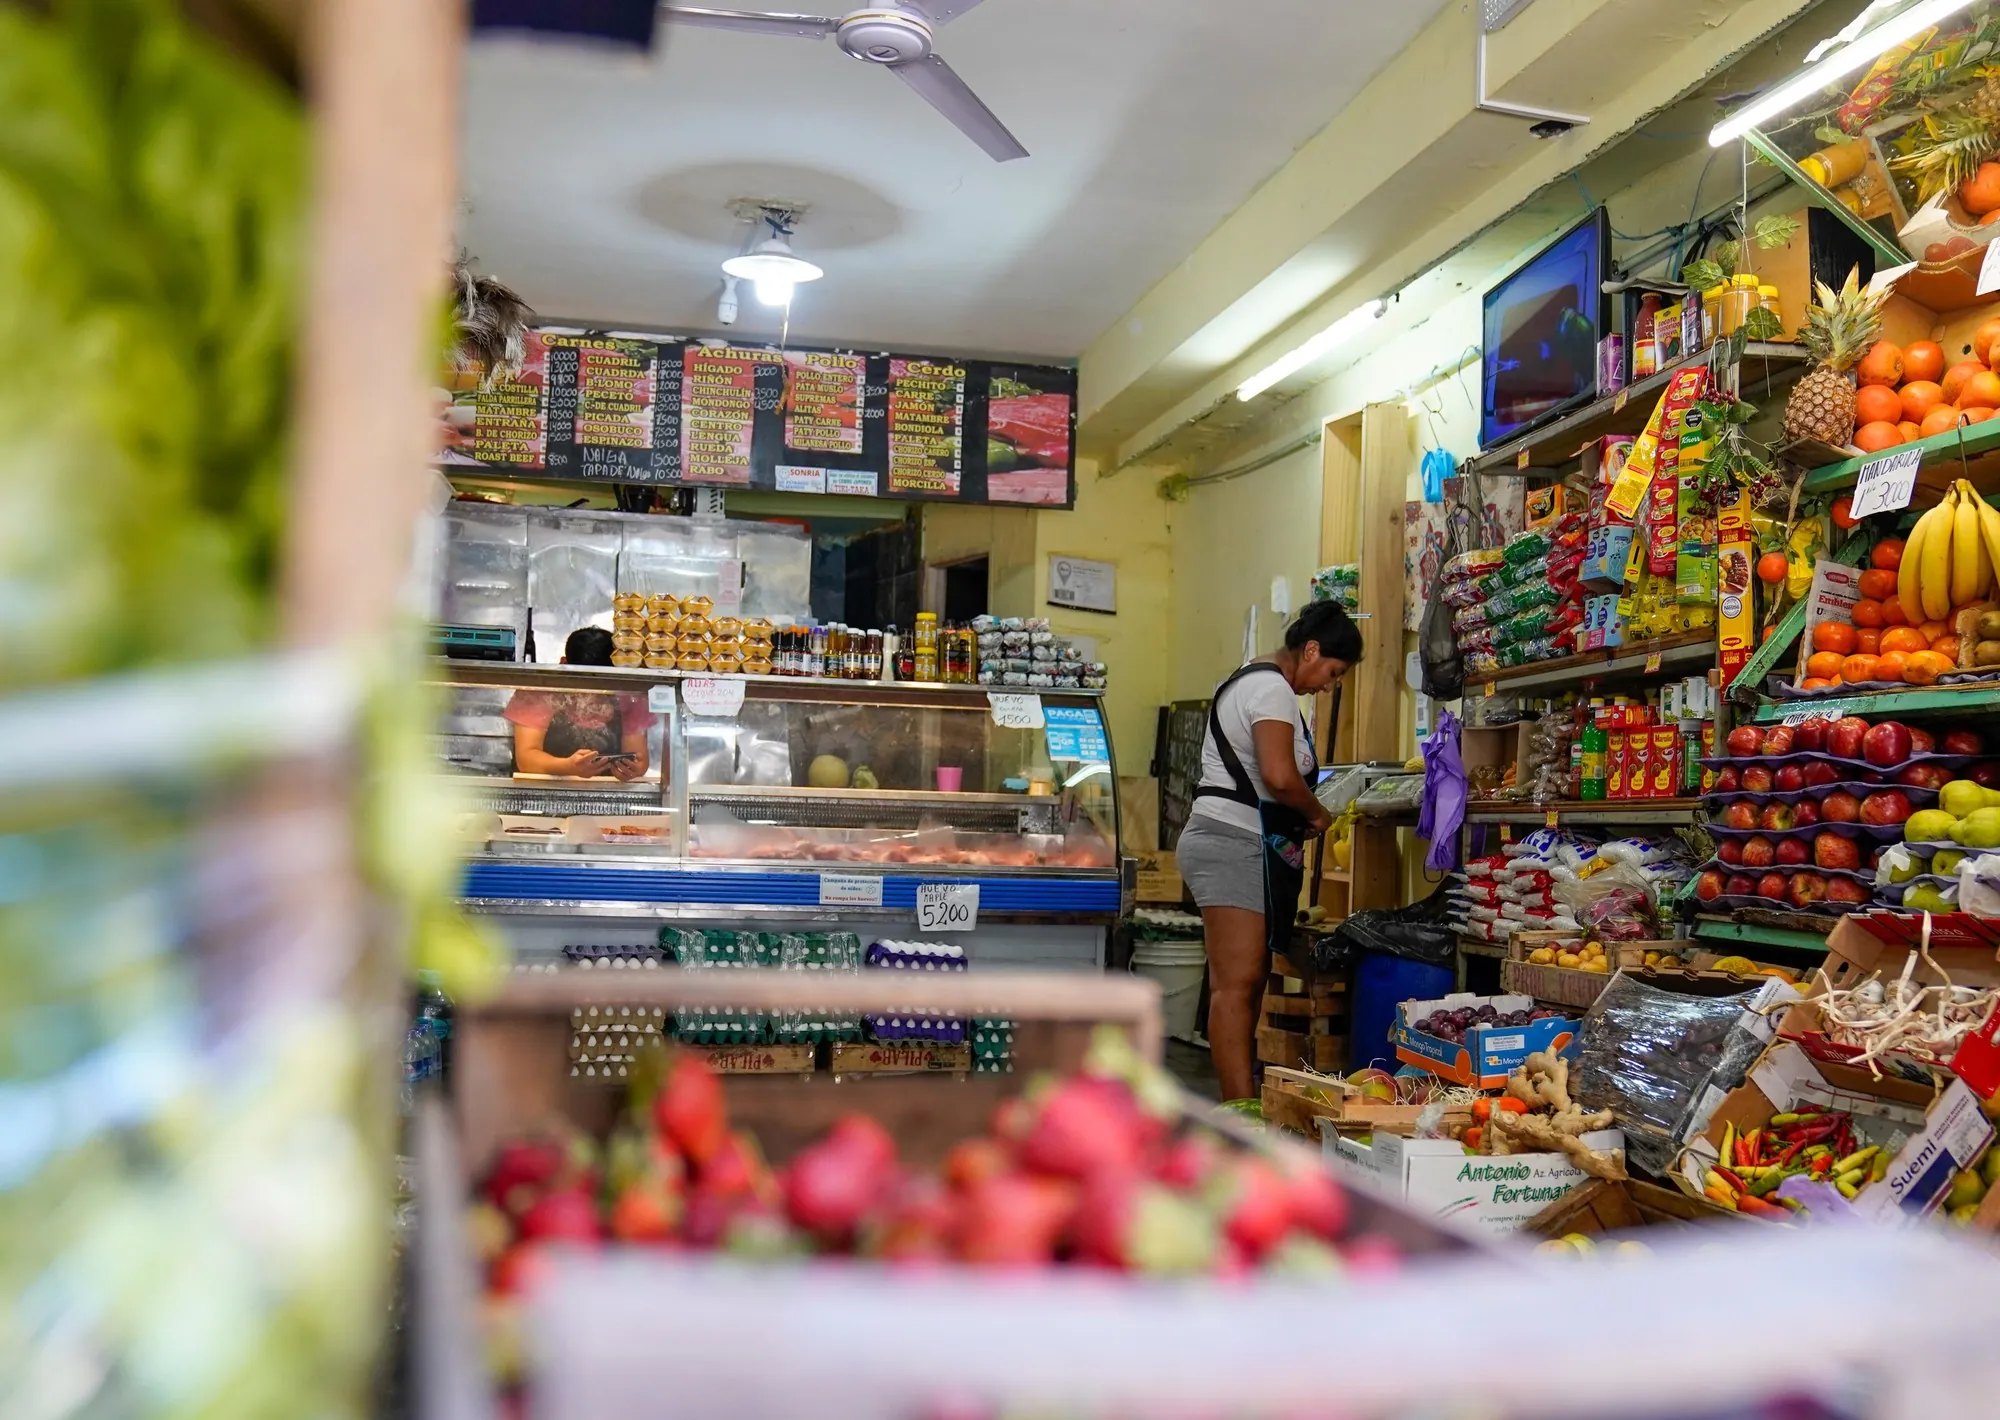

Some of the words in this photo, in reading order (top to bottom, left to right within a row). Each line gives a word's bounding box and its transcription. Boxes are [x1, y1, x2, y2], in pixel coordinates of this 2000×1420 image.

[541, 333, 616, 350] Carnes
[698, 346, 783, 362] Achuras
[586, 355, 641, 367] CUADRIL
[807, 354, 858, 369] Pollo
[694, 363, 743, 375] HÍGADO
[907, 362, 966, 377] Cerdo
[693, 374, 733, 385] RIÑÓN
[796, 371, 821, 380] POLLO
[823, 372, 854, 383] ENTERO
[500, 383, 539, 394] COSTILLA
[795, 383, 815, 392] PATA
[817, 384, 844, 393] MUSLO
[896, 379, 946, 391] PECHITO
[585, 390, 634, 401] PECETO
[692, 386, 752, 398] CHINCHULÍN
[895, 390, 935, 401] CARRE
[692, 397, 751, 409] MONDONGO
[795, 394, 837, 404] SUPREMAS
[477, 406, 537, 417] MATAMBRE
[608, 403, 643, 412] CUADRIL
[794, 405, 822, 414] ALITAS
[895, 401, 935, 412] JAMÓN
[584, 413, 631, 424] PICADA
[691, 409, 749, 420] CORAZÓN
[895, 411, 950, 424] MATAMBRE
[476, 417, 537, 429] ENTRAÑA
[691, 420, 742, 431] CENTRO
[794, 415, 814, 424] PATY
[815, 417, 842, 426] CARNE
[476, 429, 484, 438] B.
[487, 430, 498, 439] DE
[500, 431, 537, 440] CHORIZO
[583, 424, 643, 435] OSOBUCO
[793, 427, 814, 436] PATY
[815, 428, 840, 438] POLLO
[894, 423, 944, 435] BONDIOLA
[583, 435, 643, 447] ESPINAZO
[690, 431, 741, 442] LENGUA
[894, 434, 937, 445] PALETA
[1681, 435, 1701, 444] Knorr
[475, 440, 528, 451] PALETA
[690, 442, 733, 453] RUEDA
[793, 438, 827, 448] MILANESA
[829, 440, 852, 450] POLLO
[893, 445, 922, 455] CHORIZO
[924, 447, 949, 457] CASERO
[475, 452, 507, 461] ROAST
[509, 453, 535, 463] BEEF
[689, 453, 749, 465] MOLLEJA
[893, 456, 922, 466] CHORIZO
[689, 465, 725, 475] RABO
[790, 469, 820, 477] SONRIA
[893, 467, 922, 477] CHORIZO
[923, 469, 946, 479] CERDO
[893, 479, 946, 490] MORCILLA
[998, 715, 1031, 725] 1500
[920, 885, 956, 893] HUEVO
[923, 893, 947, 903] MAPLE
[922, 902, 969, 927] 5200
[720, 1058, 761, 1070] PILAR
[882, 1050, 922, 1067] PILAR
[1457, 1161, 1531, 1182] Antonio
[1548, 1167, 1582, 1179] Agricola
[1492, 1182, 1572, 1204] Fortunat
